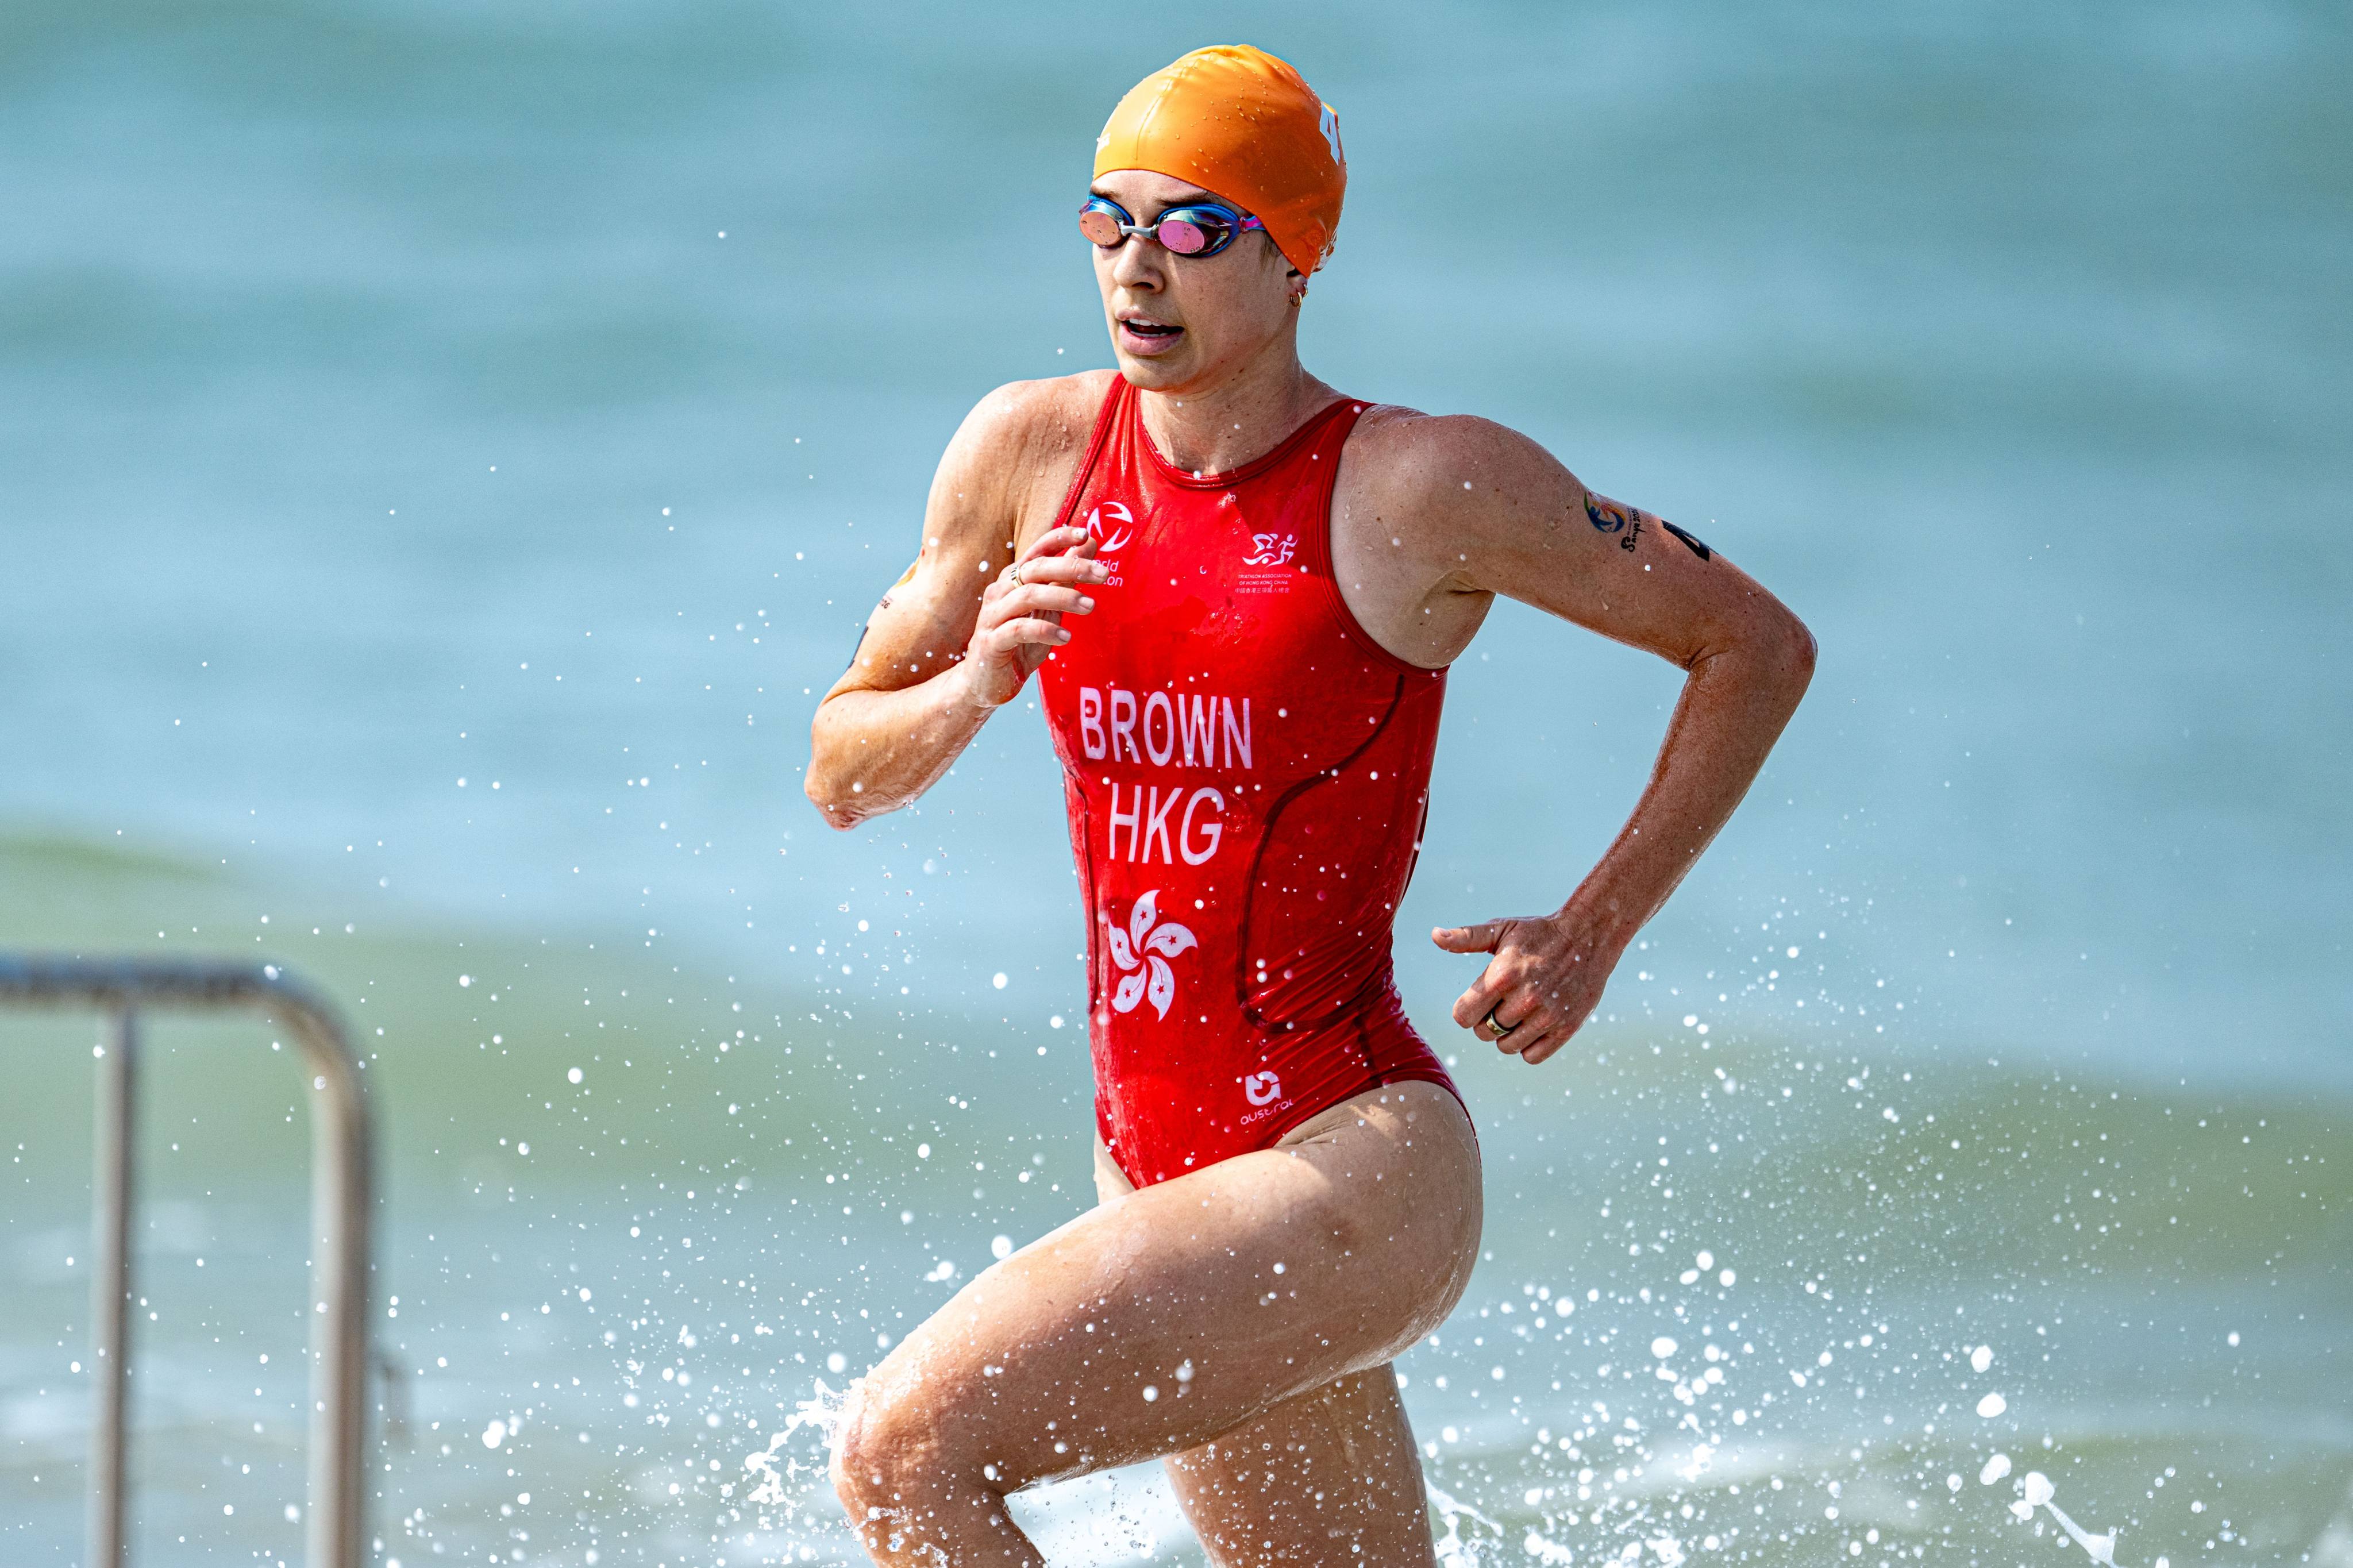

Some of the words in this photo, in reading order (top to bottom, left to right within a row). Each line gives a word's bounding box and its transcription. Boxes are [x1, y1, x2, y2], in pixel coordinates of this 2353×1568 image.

[1621, 523, 1646, 553] Sanya
[1094, 558, 1119, 572] rld
[1080, 686, 1253, 769] BROWN
[1109, 782, 1225, 866] HKG
[1239, 1099, 1295, 1126] austral
